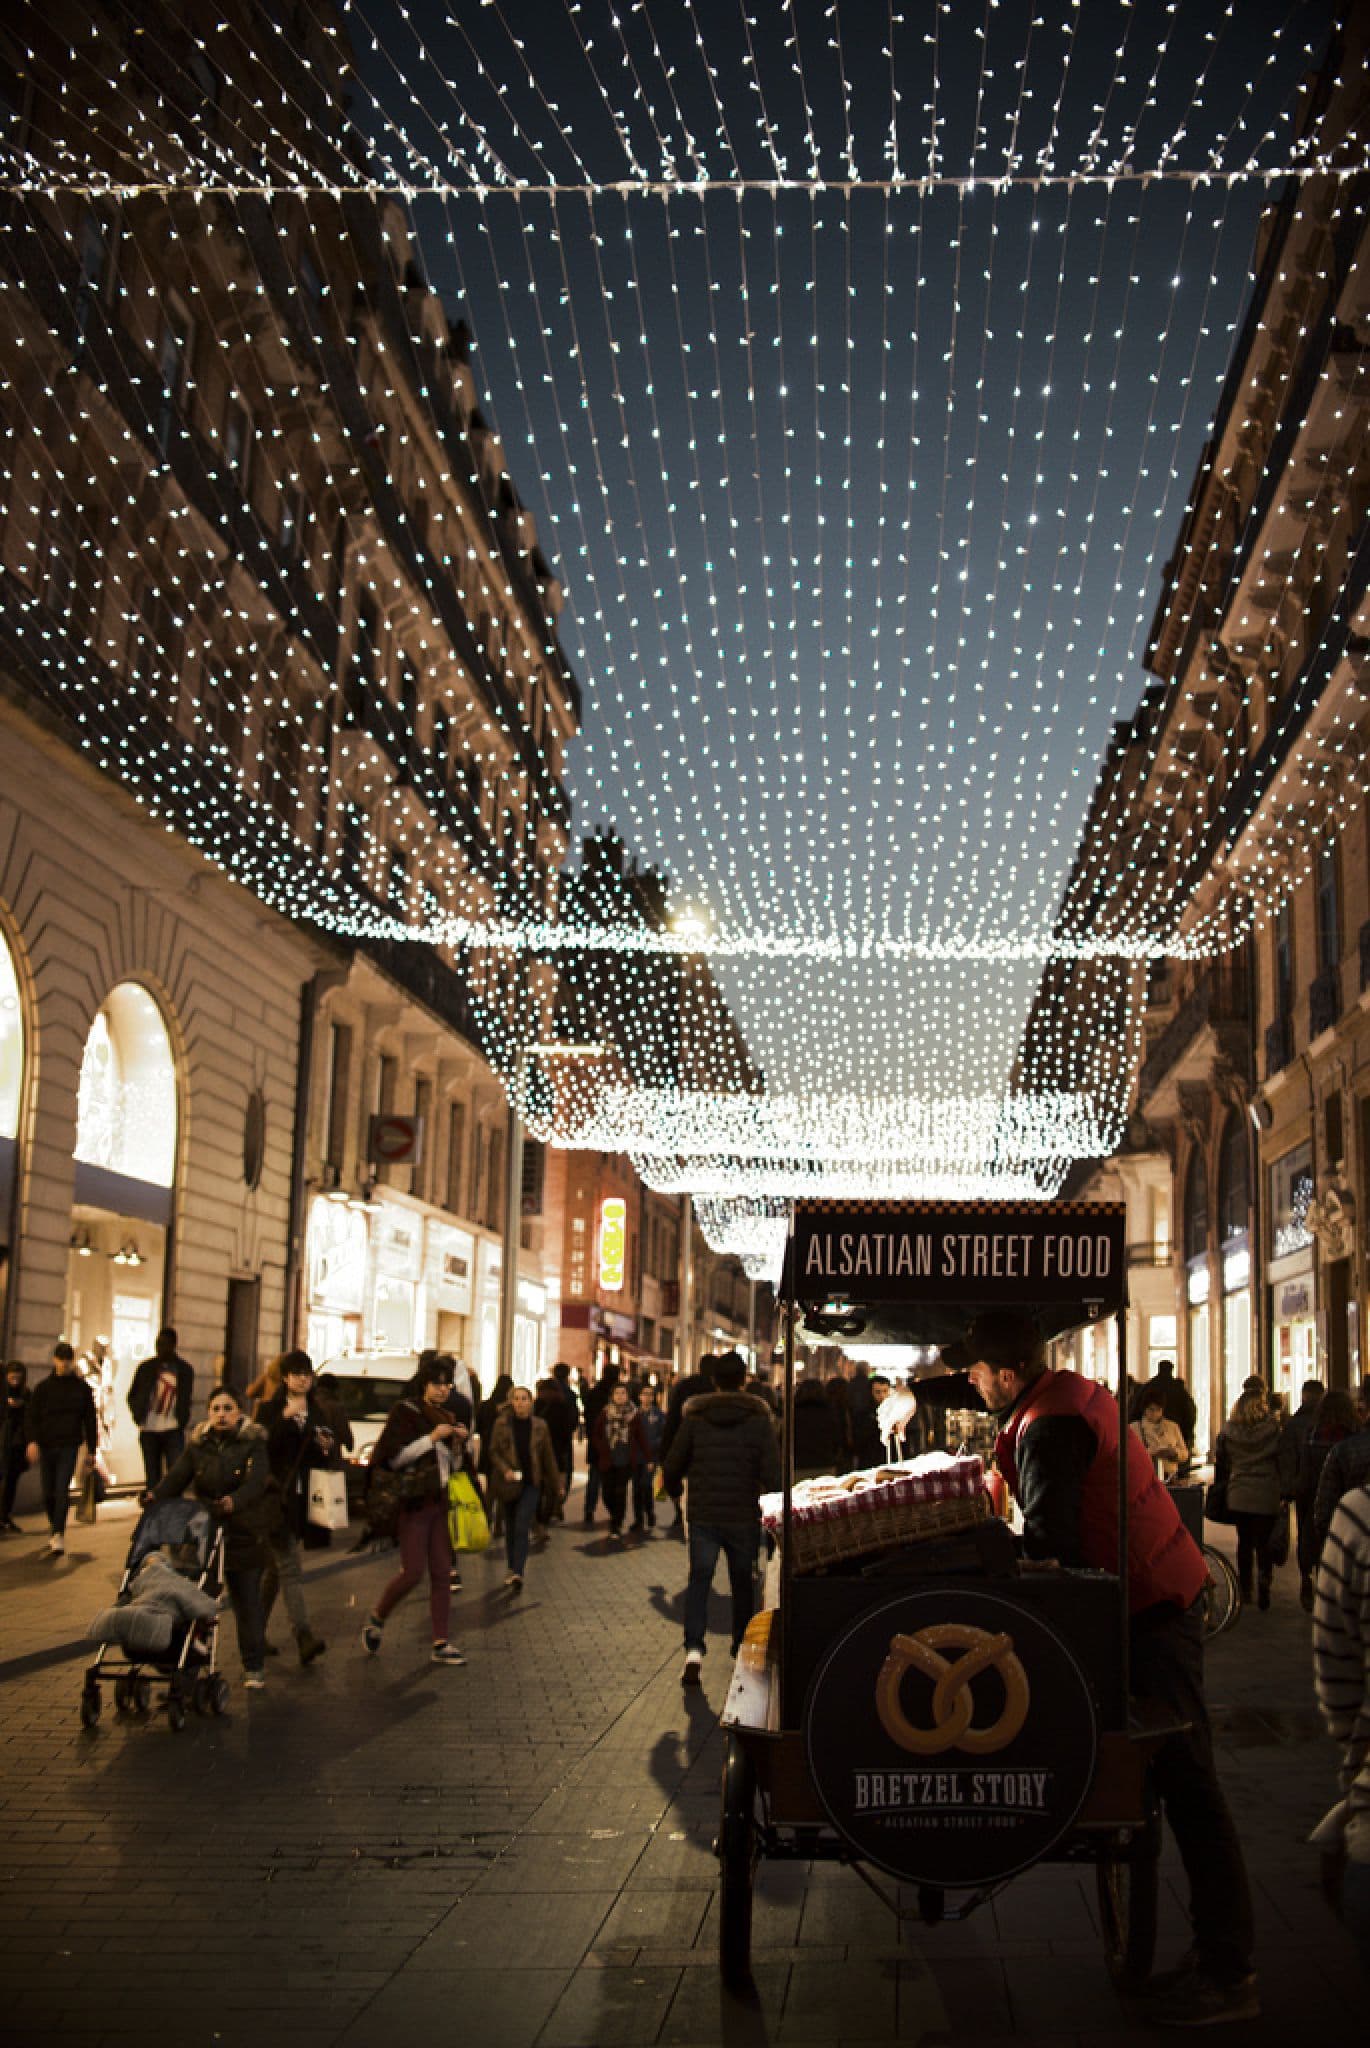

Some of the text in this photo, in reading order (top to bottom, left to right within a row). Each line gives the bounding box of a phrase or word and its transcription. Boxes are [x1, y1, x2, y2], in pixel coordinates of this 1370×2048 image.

[805, 1233, 1111, 1277] ALSATIAN STREET FOOD
[855, 1773, 1047, 1808] BRETZEL STORY
